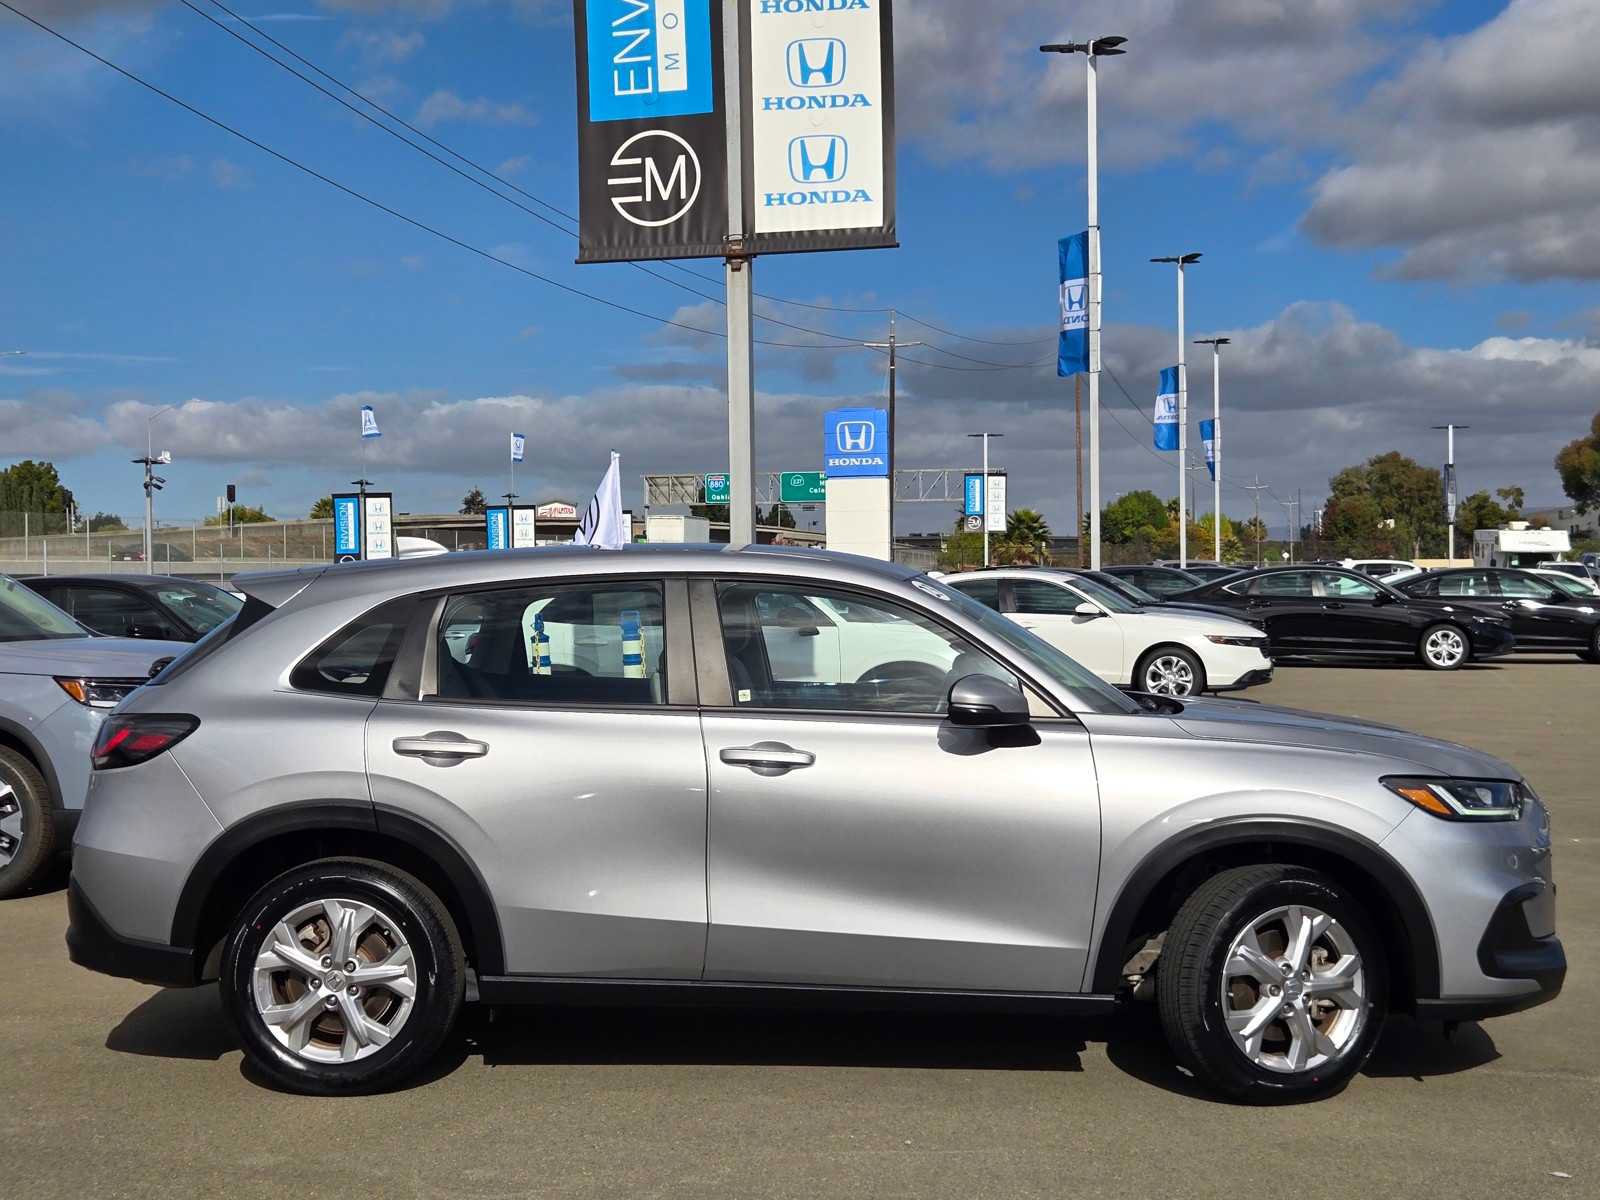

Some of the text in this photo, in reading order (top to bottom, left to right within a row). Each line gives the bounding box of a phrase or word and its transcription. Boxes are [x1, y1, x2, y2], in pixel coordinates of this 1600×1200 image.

[759, 0, 871, 14] HONDA
[761, 93, 873, 111] HONDA
[764, 189, 873, 207] HONDA
[828, 457, 884, 466] HONDA
[710, 480, 724, 488] 880
[339, 502, 349, 550] ENVISION
